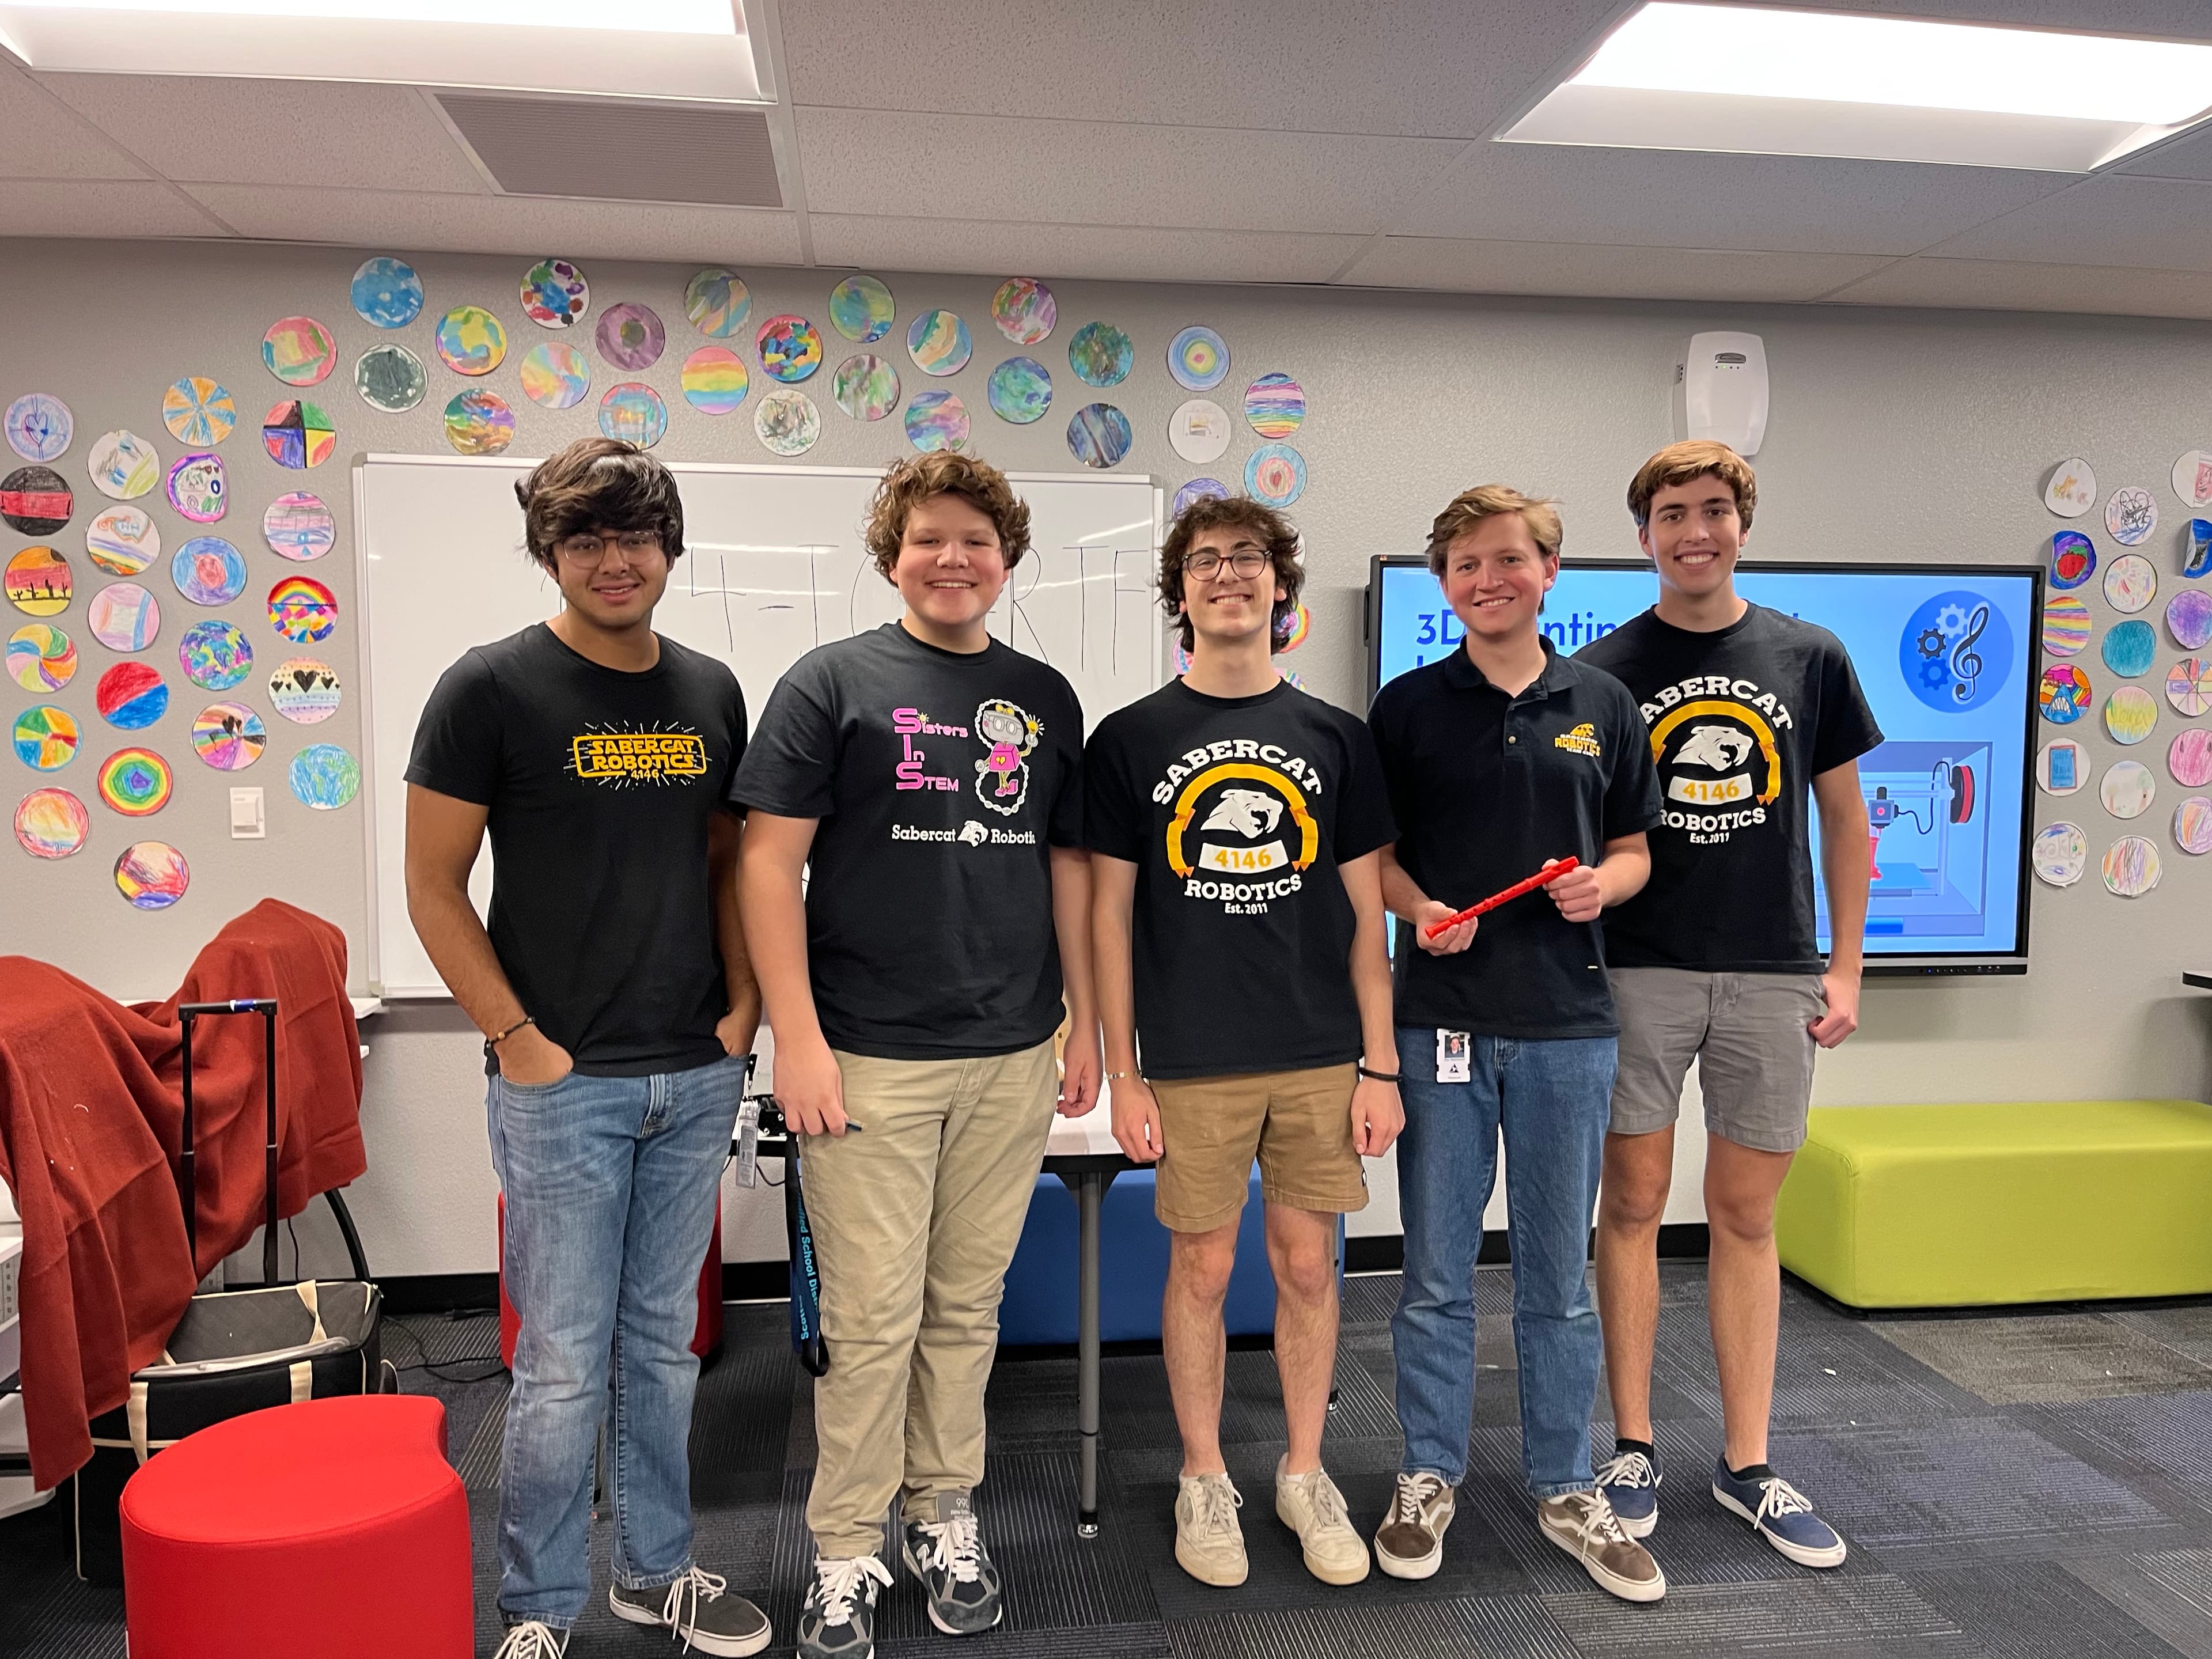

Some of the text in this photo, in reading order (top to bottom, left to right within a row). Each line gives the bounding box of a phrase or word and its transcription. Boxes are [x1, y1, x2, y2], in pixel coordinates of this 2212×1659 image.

[1416, 609, 1466, 646] 3D
[1639, 675, 1794, 730] ABERCAT
[892, 707, 969, 738] Sisters
[589, 740, 694, 755] SABERCAT
[903, 733, 926, 762] In
[1554, 737, 1601, 757] ROBOTICS
[592, 754, 694, 770] ROBOTICS
[631, 768, 660, 779] 4146
[1152, 738, 1323, 805] SABERCAT
[896, 761, 959, 792] STEM
[1681, 779, 1740, 801] 4146
[891, 824, 956, 842] Sabercat
[1690, 832, 1730, 844] Est. 2011
[1213, 848, 1272, 870] 4146
[1184, 873, 1303, 902] ROBOTICS
[1224, 902, 1268, 915] Est. 2011
[801, 1236, 816, 1277] School
[799, 1294, 809, 1340] Scott
